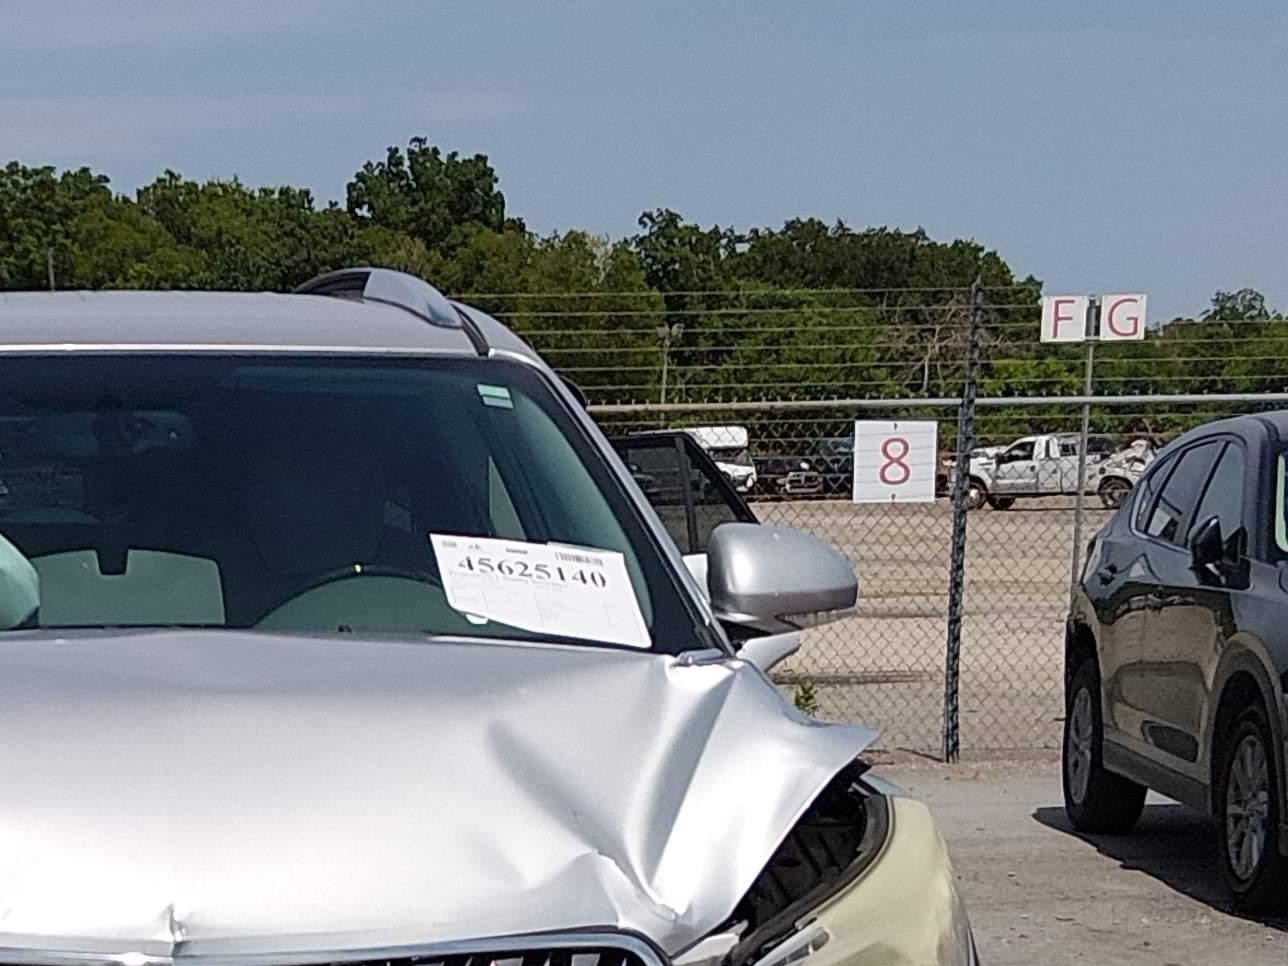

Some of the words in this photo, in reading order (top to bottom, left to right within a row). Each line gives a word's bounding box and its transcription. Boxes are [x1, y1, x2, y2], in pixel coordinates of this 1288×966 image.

[1052, 299, 1075, 339] F
[1108, 298, 1139, 337] G
[879, 437, 911, 485] 8
[458, 556, 607, 588] 45625140
